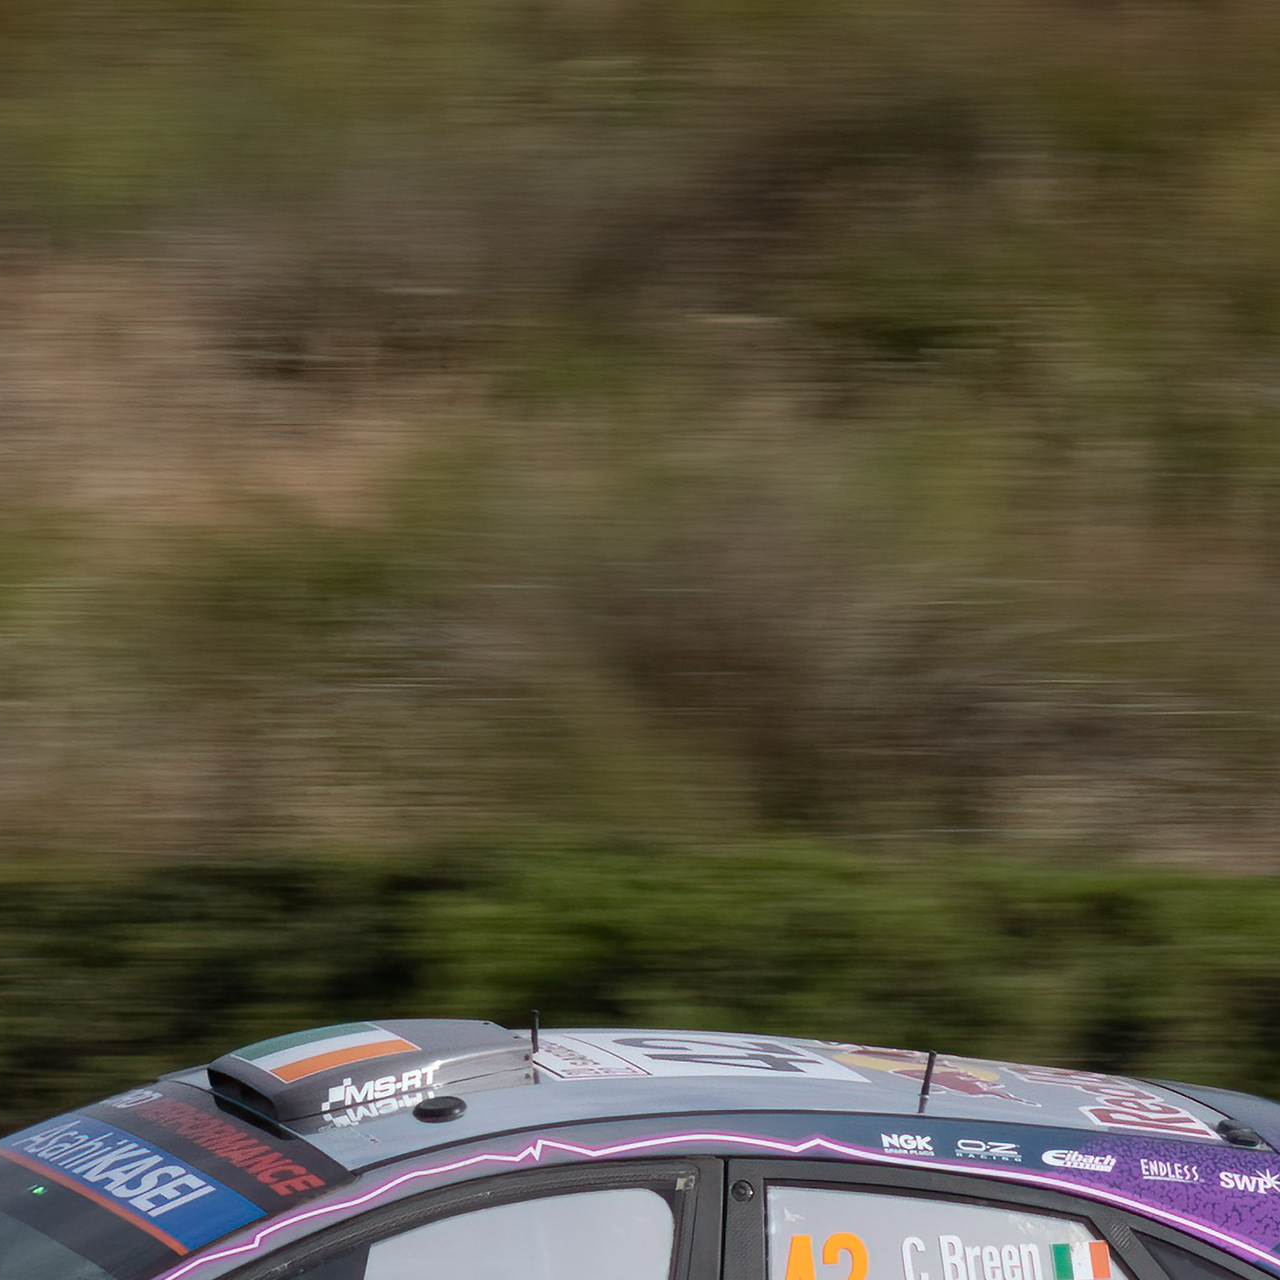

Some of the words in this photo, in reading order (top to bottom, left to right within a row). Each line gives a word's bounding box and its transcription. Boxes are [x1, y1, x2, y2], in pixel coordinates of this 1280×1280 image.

[880, 1132, 933, 1151] NGK
[1041, 1149, 1116, 1167] Eibach
[1140, 1158, 1199, 1181] ENDLESS
[1219, 1171, 1273, 1194] SWP
